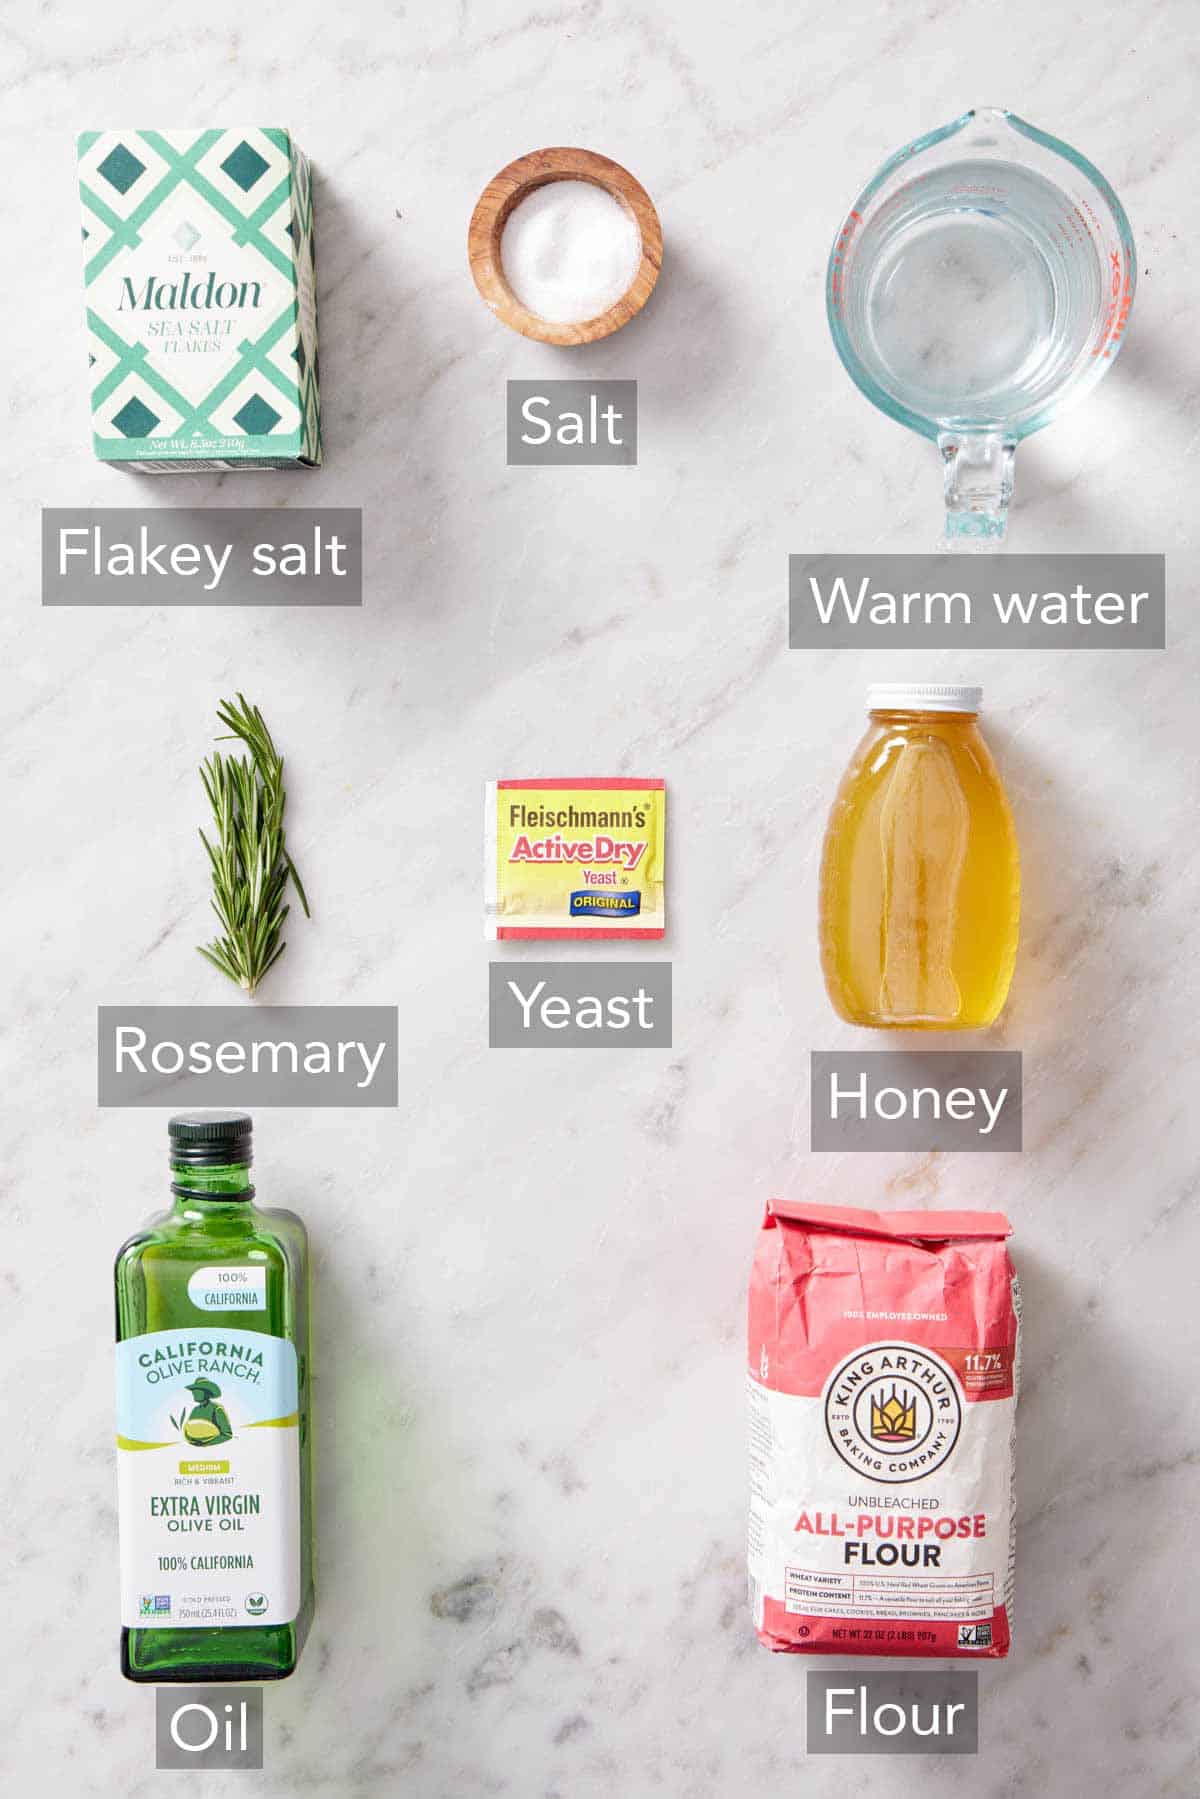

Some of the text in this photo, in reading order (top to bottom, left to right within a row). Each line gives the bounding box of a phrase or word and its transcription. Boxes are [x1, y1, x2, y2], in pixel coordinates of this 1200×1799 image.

[117, 271, 262, 311] Maldon
[147, 319, 236, 336] SEA SALT
[164, 340, 222, 353] FLAKES
[583, 870, 617, 885] Yeast
[573, 896, 635, 909] ORIGINAL
[217, 1271, 249, 1283] 100%
[204, 1292, 258, 1305] CALIFORNIA
[138, 1341, 264, 1367] CALIFORNIA
[964, 1353, 1002, 1371] 11.7%
[146, 1358, 261, 1384] OLIVE RANCH
[834, 1355, 951, 1411] KING ARTHUR
[839, 1428, 948, 1473] BAKING COMPANY
[150, 1494, 261, 1517] EXTRA VIRGIN
[848, 1495, 940, 1510] UNBLEACHED
[167, 1518, 245, 1532] OLIVE OIL
[793, 1511, 986, 1540] ALL-PURPOSE
[844, 1541, 942, 1567] FLOUR
[158, 1555, 254, 1570] 100% CALIFORNIA
[789, 1572, 842, 1585] WHEAT VARIETY
[789, 1587, 851, 1600] PROTEIN CONTENT
[832, 1628, 847, 1640] NET
[848, 1629, 861, 1640] WT
